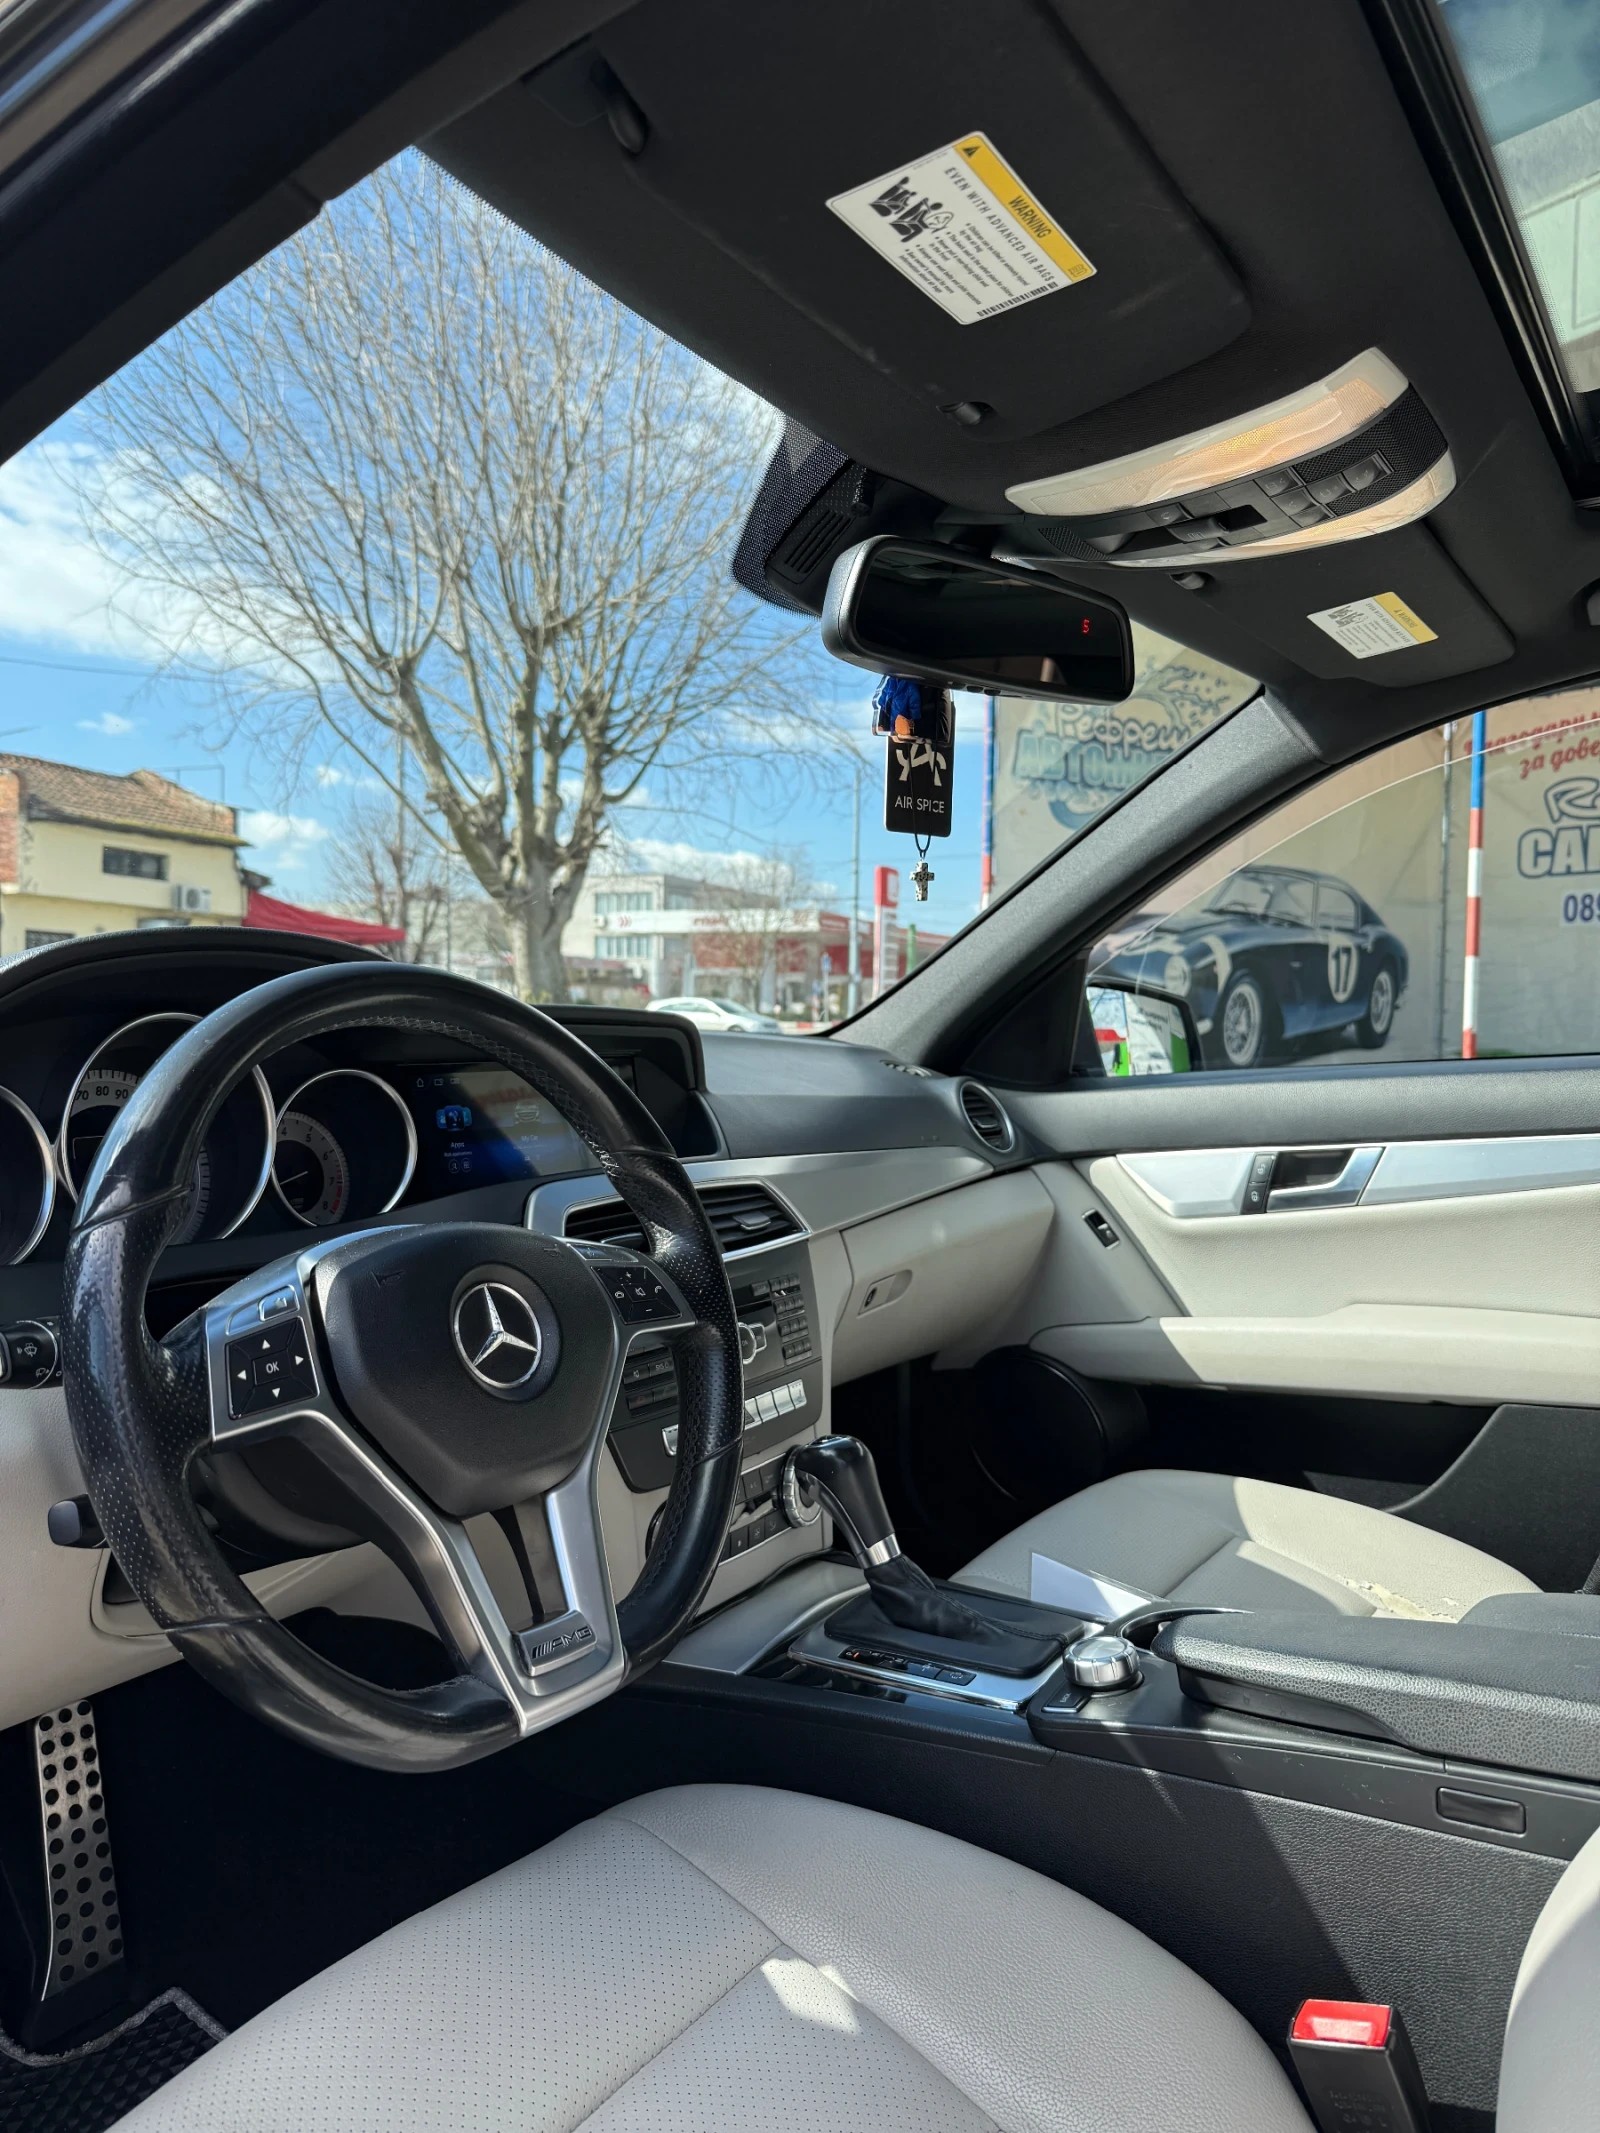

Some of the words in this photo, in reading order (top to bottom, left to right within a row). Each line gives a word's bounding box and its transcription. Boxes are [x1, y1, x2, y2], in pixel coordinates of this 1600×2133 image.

[942, 166, 971, 191] EVEN
[964, 190, 992, 214] WITH
[985, 213, 1027, 251] ADVANCED
[1020, 251, 1039, 264] AIR
[1032, 264, 1055, 282] BAGS
[1006, 195, 1053, 238] WARNING
[1520, 755, 1545, 780] за
[894, 795, 913, 809] AIR
[916, 798, 945, 814] SPICE
[1332, 947, 1351, 993] 17
[95, 1085, 109, 1097] 80
[115, 1088, 129, 1100] 90
[265, 1361, 280, 1374] OK
[550, 1626, 593, 1652] AMG
